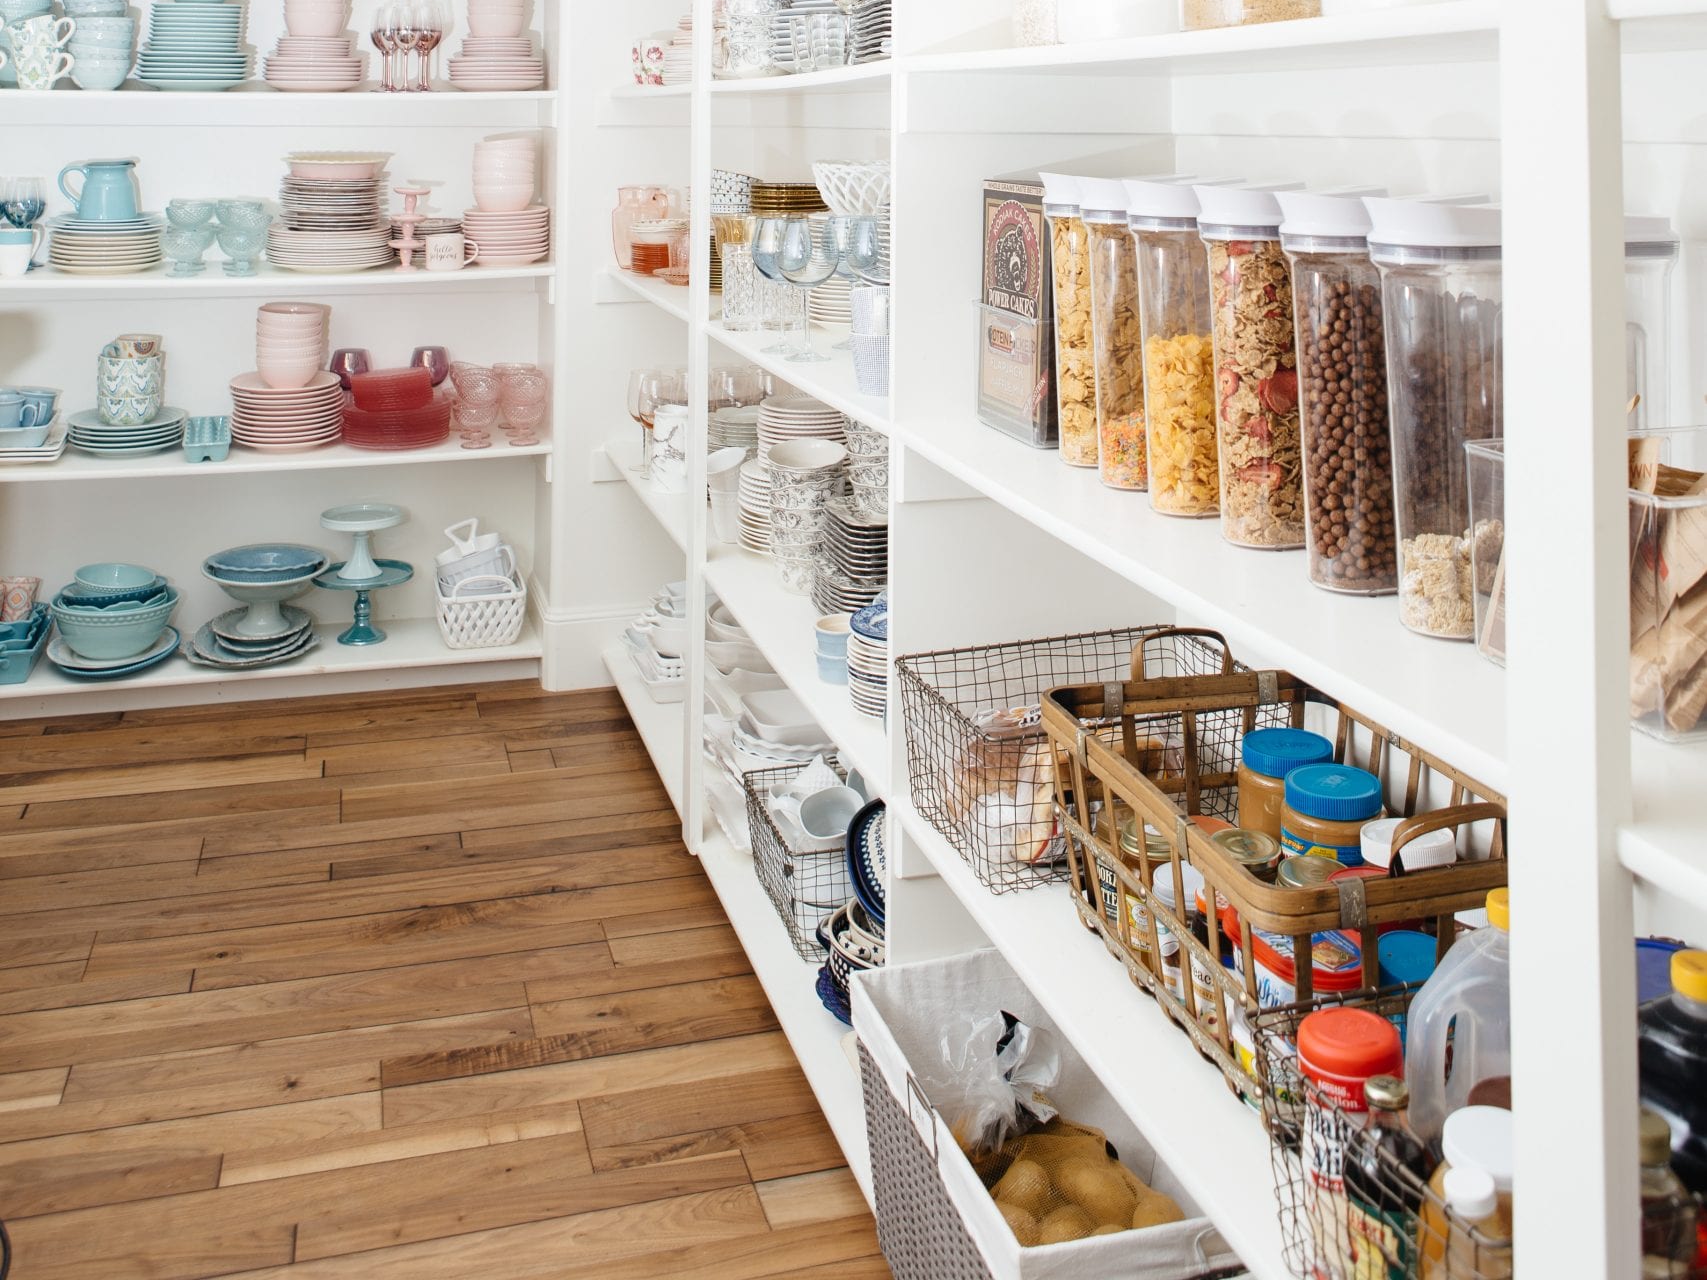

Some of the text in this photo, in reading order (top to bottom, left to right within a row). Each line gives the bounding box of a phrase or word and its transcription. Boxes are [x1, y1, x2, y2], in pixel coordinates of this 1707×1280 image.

[993, 208, 1032, 242] KODIAK CAKES
[988, 288, 1035, 319] POWER CAKES
